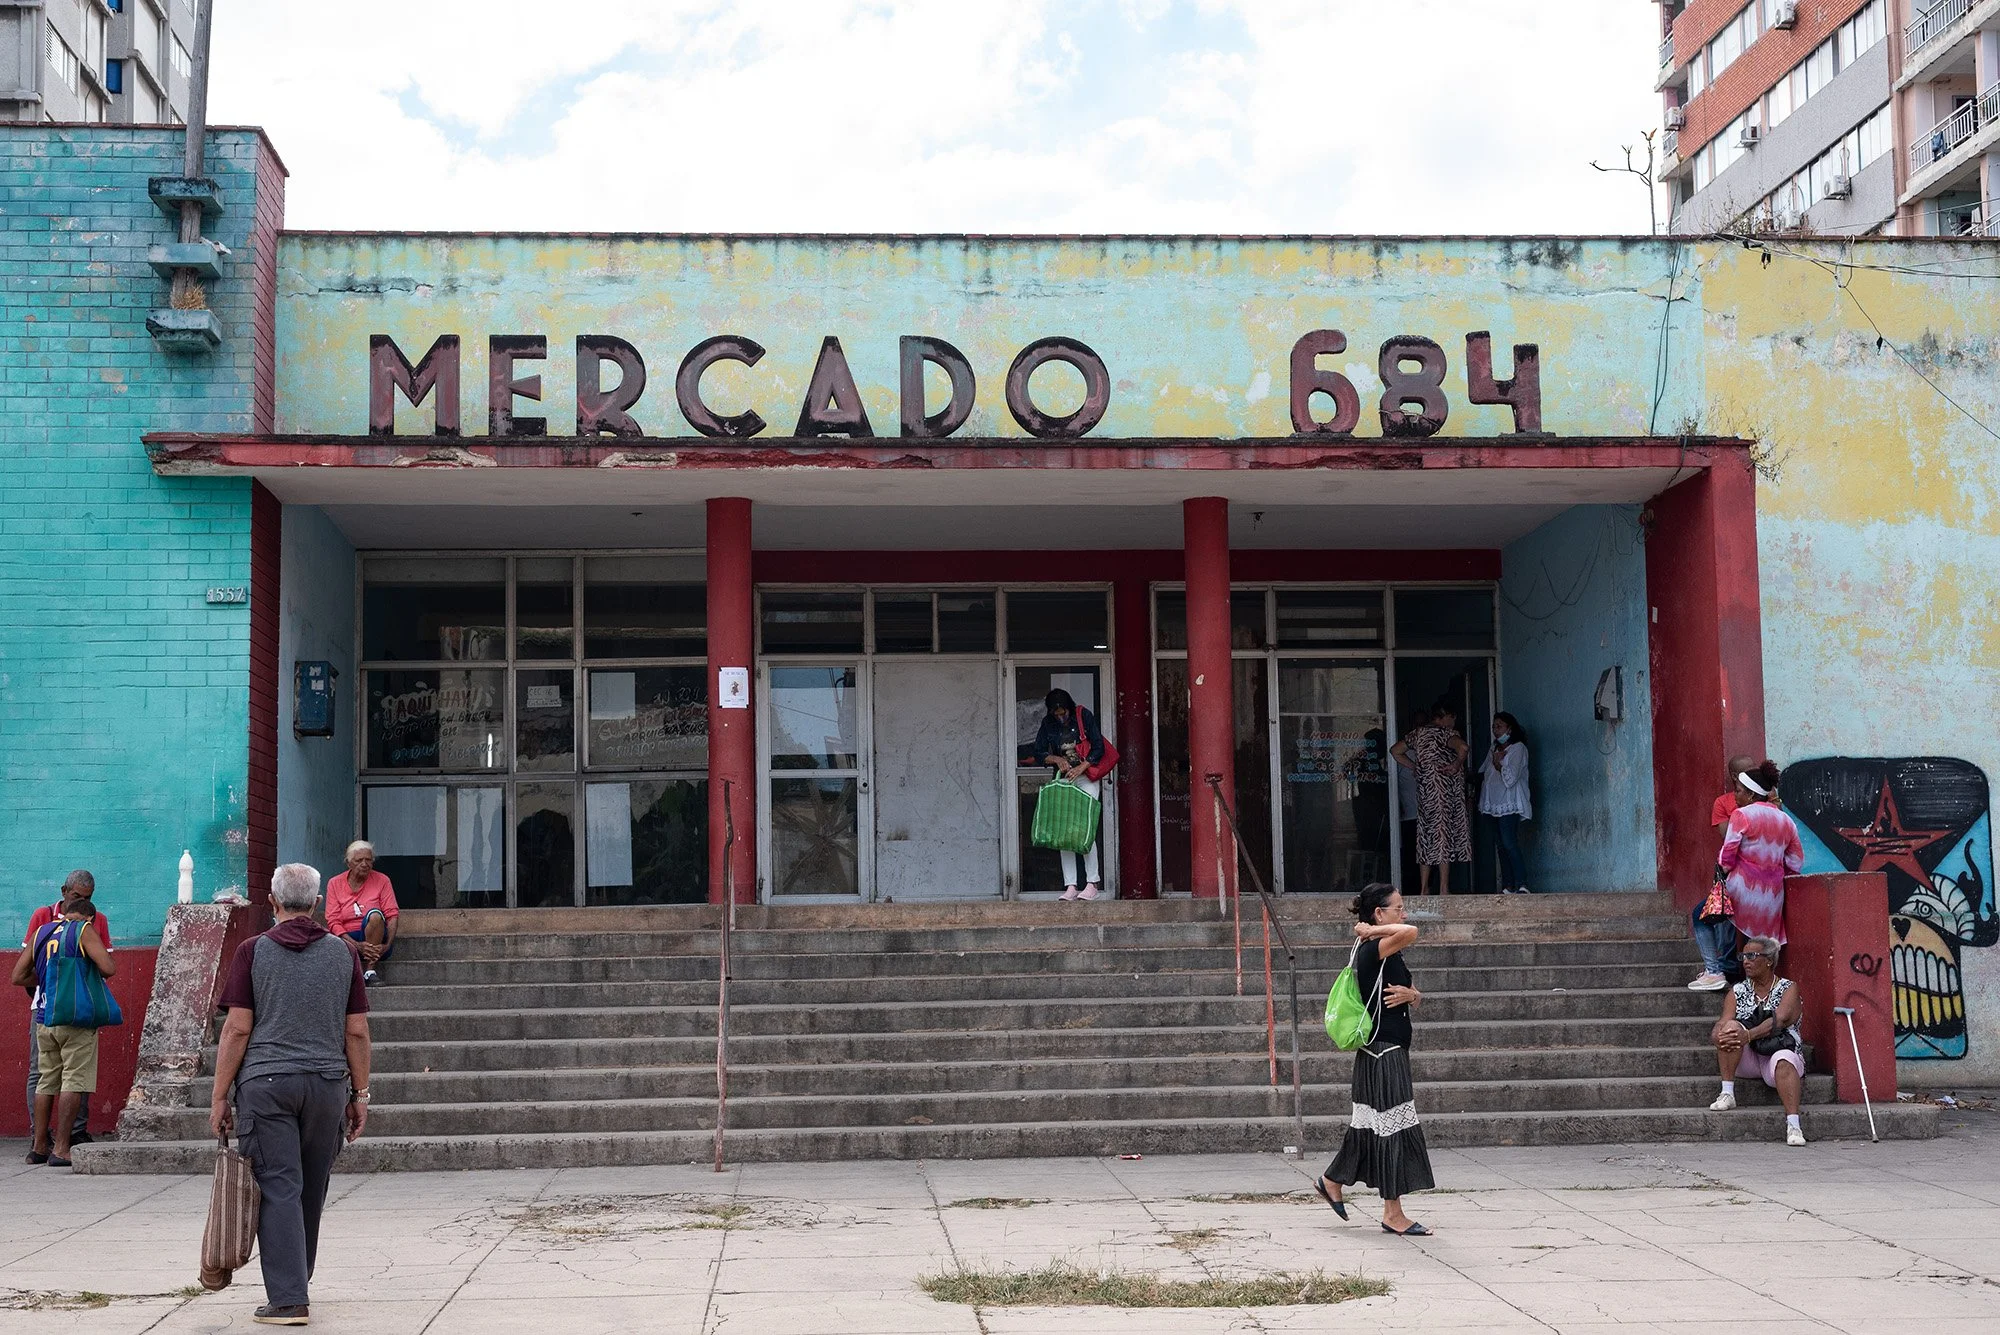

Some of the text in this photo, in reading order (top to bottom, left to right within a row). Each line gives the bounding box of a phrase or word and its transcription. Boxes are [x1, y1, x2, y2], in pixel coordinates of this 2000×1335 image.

[369, 329, 1543, 440] MERCADO 684
[206, 587, 246, 602] 1557
[1310, 731, 1360, 740] HORARIO
